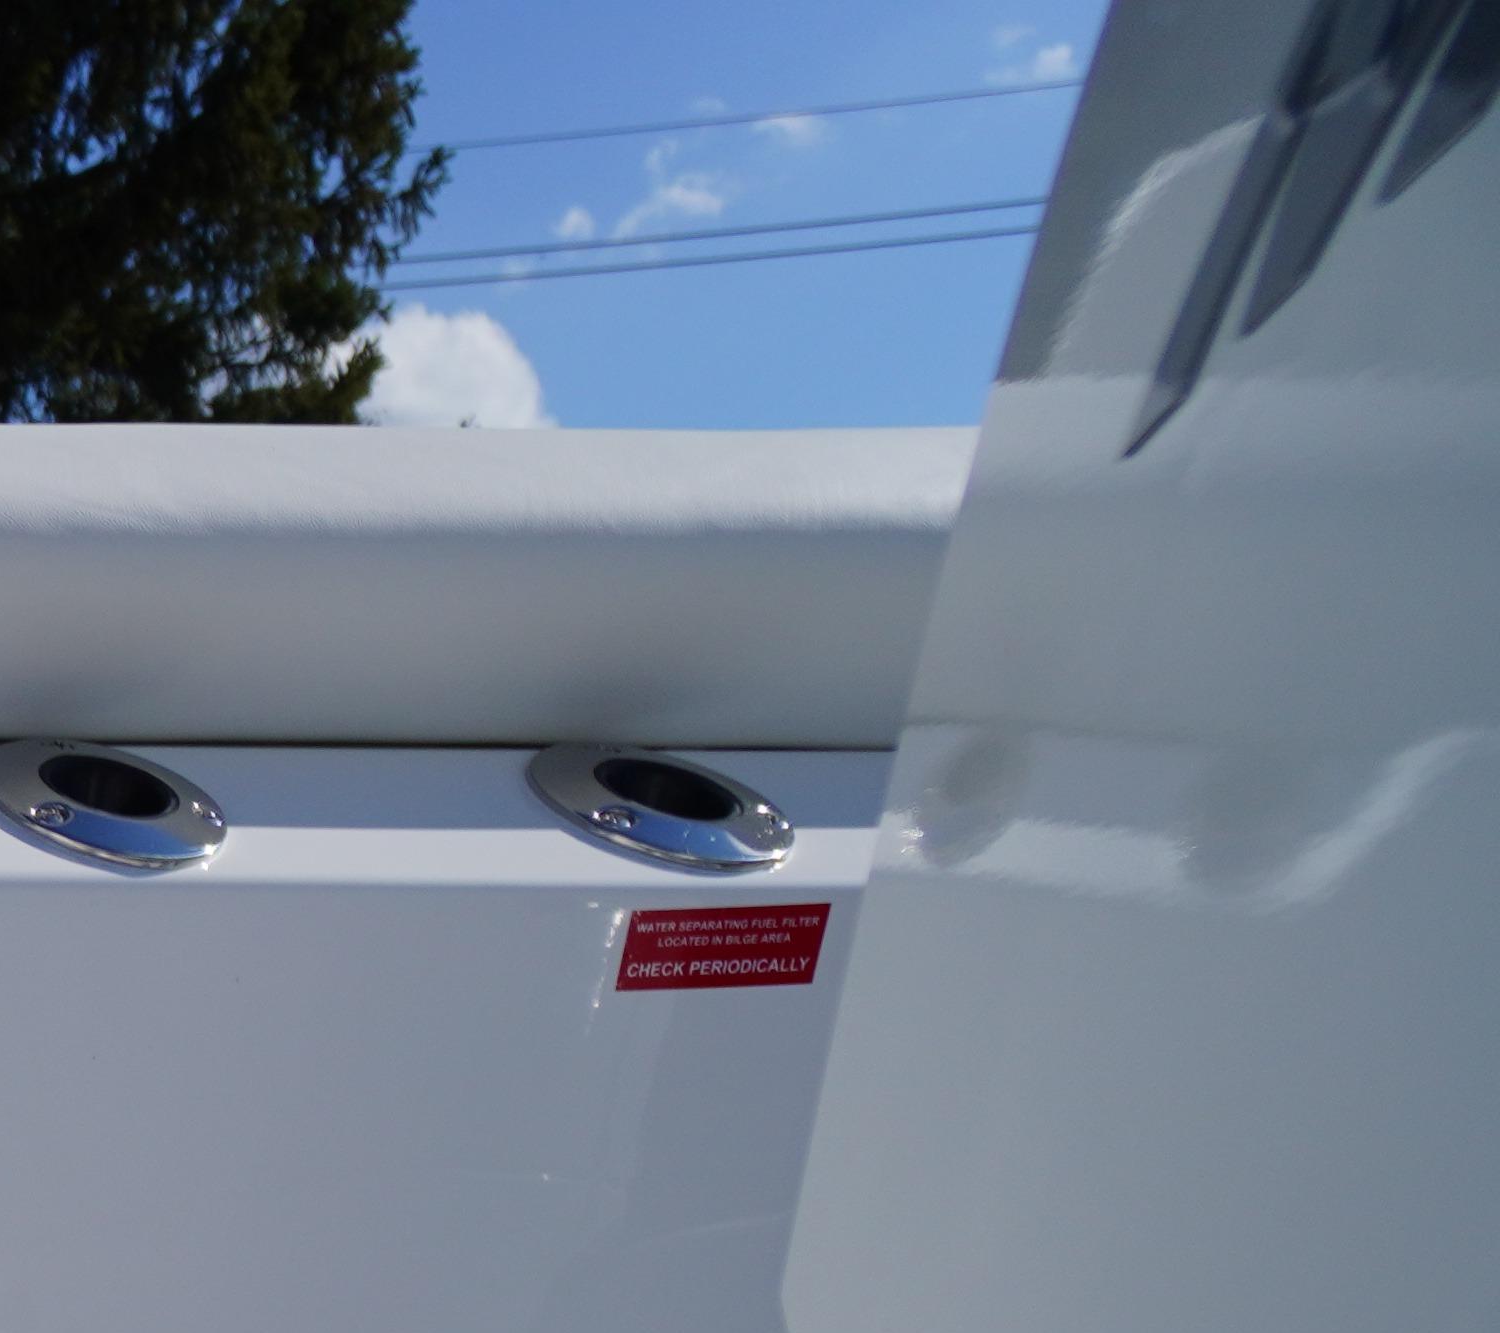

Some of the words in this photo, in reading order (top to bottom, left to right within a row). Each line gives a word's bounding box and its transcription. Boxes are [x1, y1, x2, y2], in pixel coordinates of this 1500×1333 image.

[637, 920, 677, 933] WATER
[679, 918, 748, 932] SEPARATING
[752, 917, 779, 929] FUEL
[782, 916, 820, 928] FILTER
[658, 935, 709, 948] LOCATED
[711, 935, 723, 946] IN
[725, 934, 758, 946] BILGE
[761, 932, 791, 945] AREA
[627, 962, 686, 978] CHECK
[689, 957, 811, 976] PERIODICALLY
